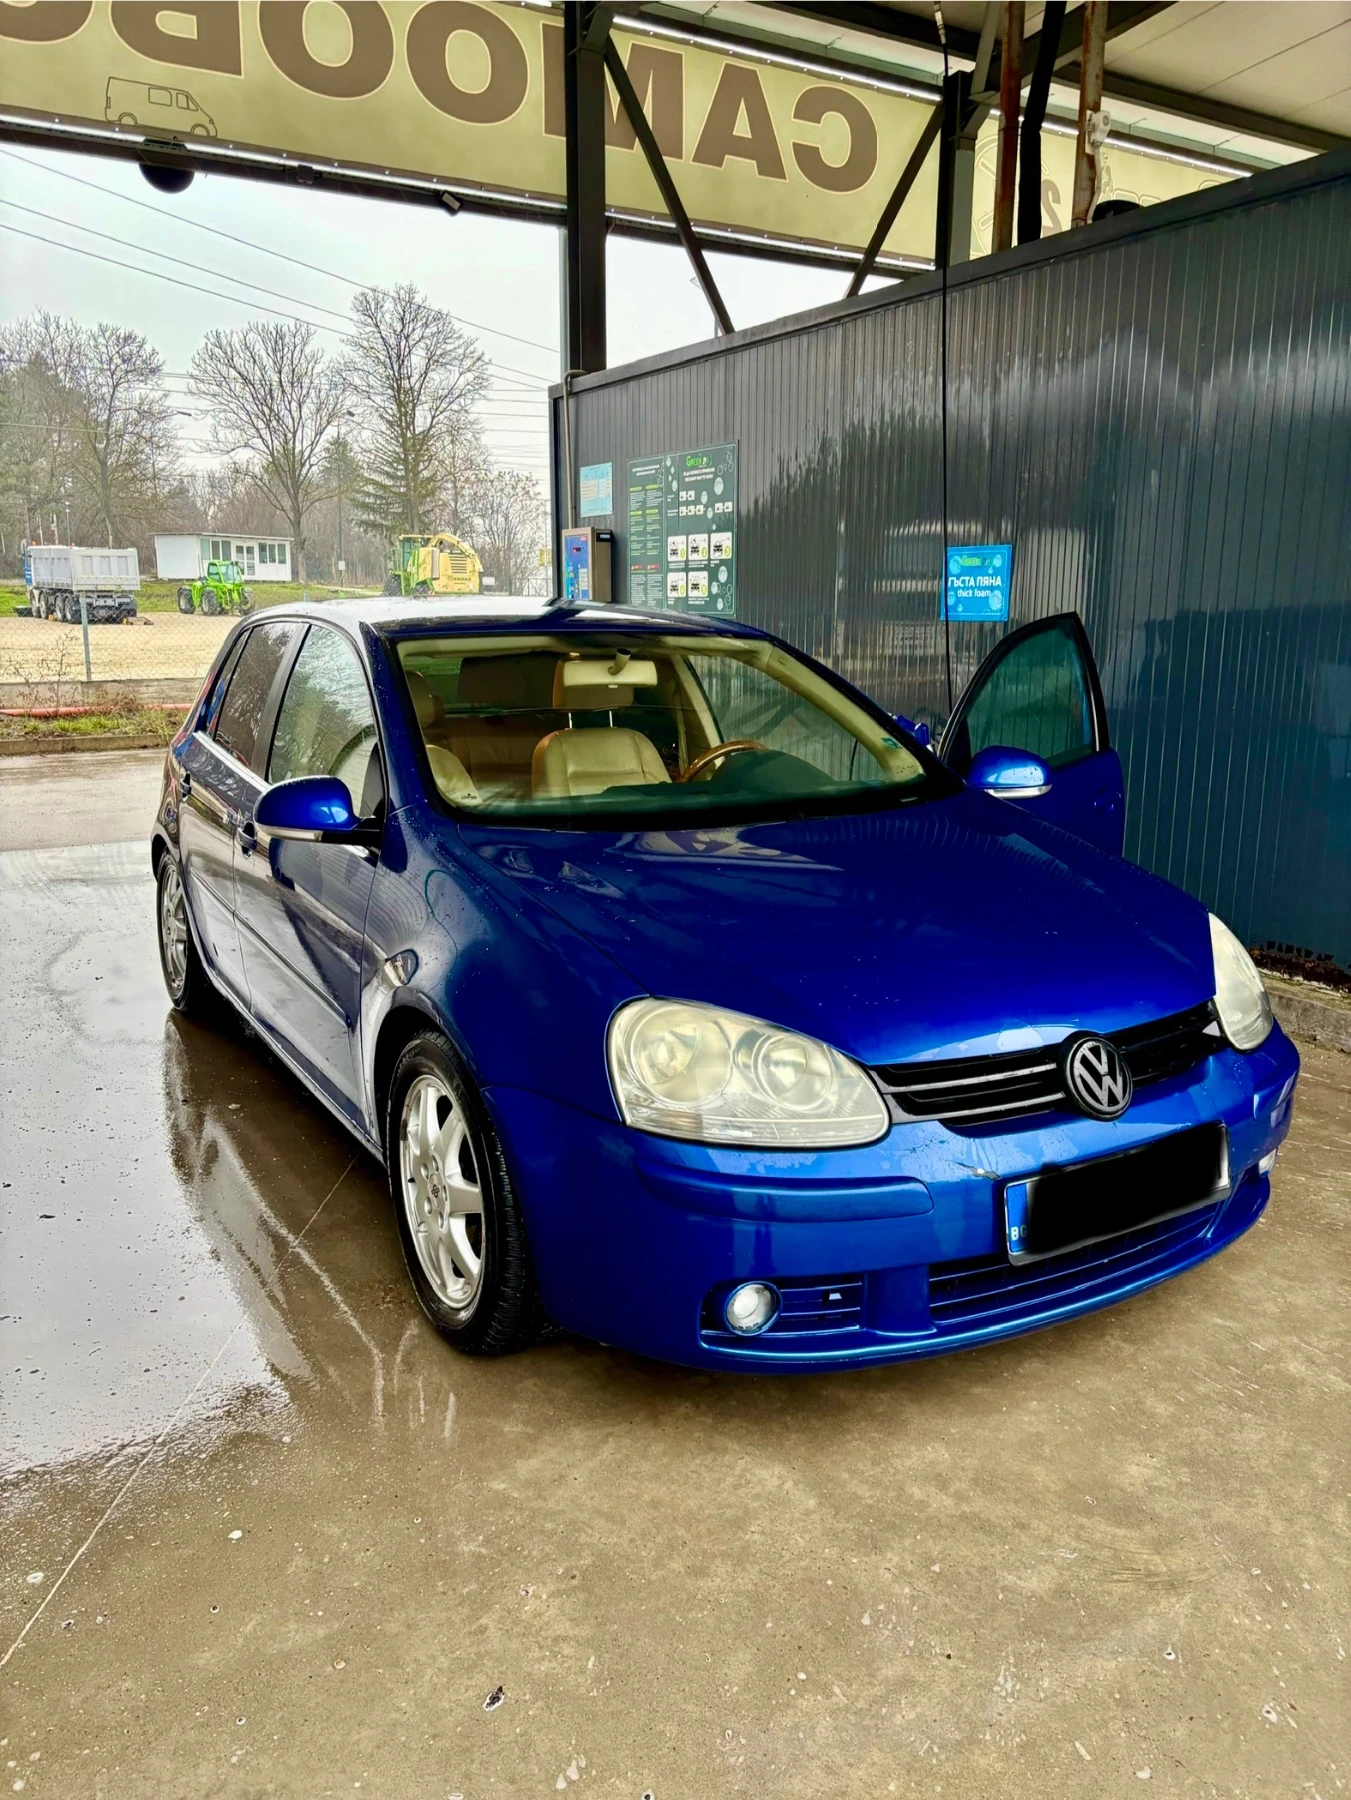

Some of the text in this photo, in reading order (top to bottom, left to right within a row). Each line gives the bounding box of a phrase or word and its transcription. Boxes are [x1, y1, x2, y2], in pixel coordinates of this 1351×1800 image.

[948, 576, 1002, 588] ГЪСТА ПЯНА
[957, 589, 992, 597] thick foam
